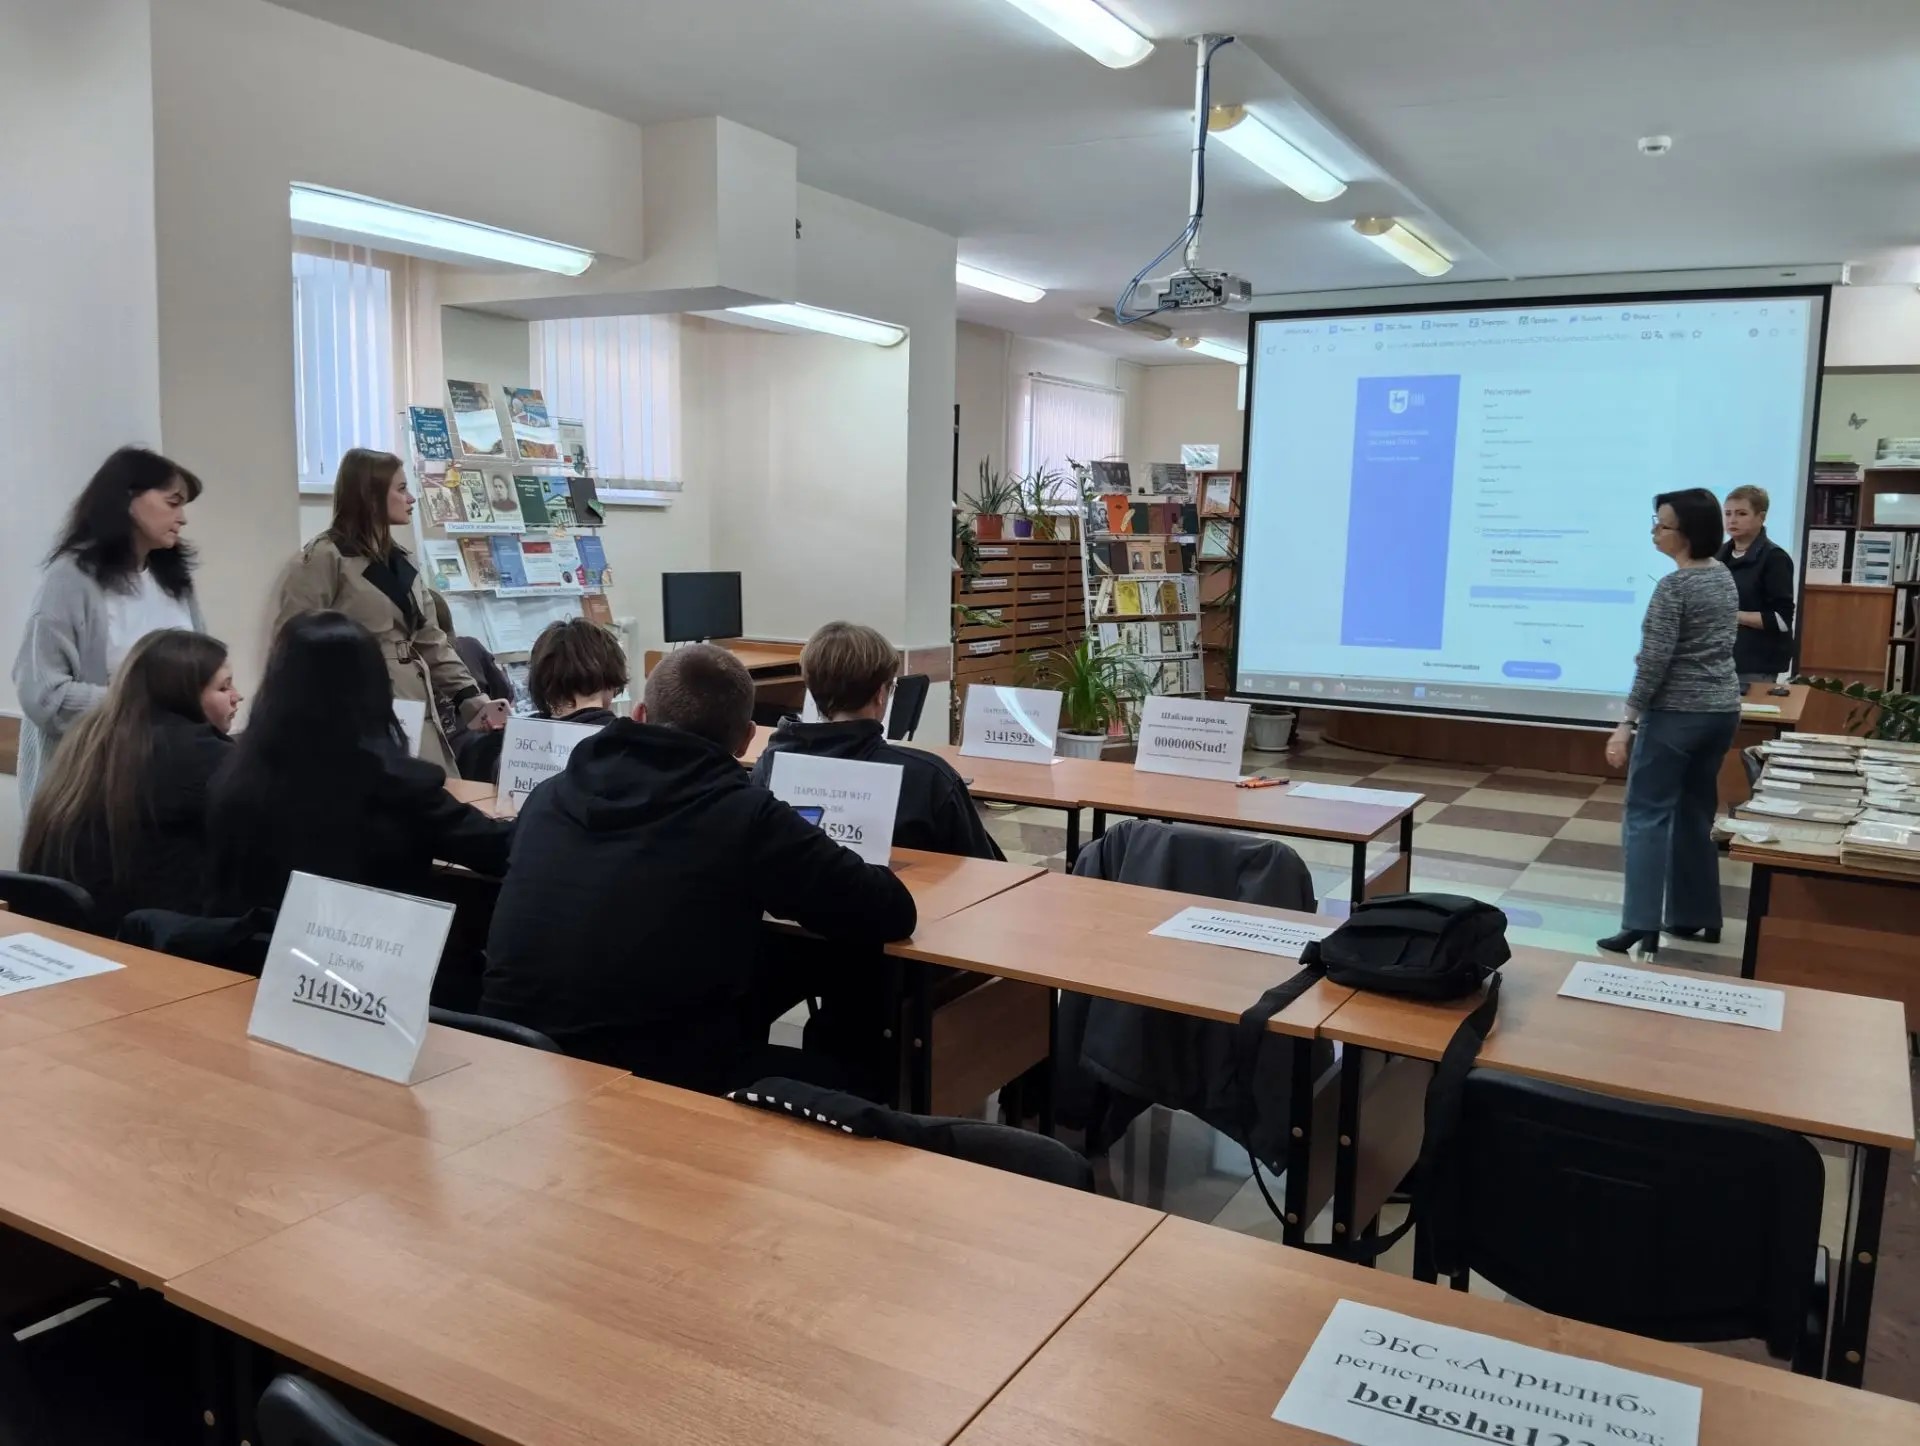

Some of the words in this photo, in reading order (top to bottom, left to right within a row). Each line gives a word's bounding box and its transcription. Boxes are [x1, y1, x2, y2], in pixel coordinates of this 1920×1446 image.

[515, 738, 537, 751] ЭБС
[984, 730, 1035, 744] 31415926
[1154, 736, 1227, 754] 000000Stud!
[794, 785, 828, 797] ПАРОЛЬ
[305, 921, 348, 945] ПАРОЛЬ
[348, 932, 374, 950] ДЛЯ
[375, 938, 405, 957] WI-FI
[294, 974, 388, 1020] 31415926
[1597, 986, 1749, 1016] belgsha1236
[1360, 1328, 1439, 1361] ЭБС
[1446, 1357, 1657, 1418] «Агрилиб»
[1334, 1351, 1597, 1428] регистрационный
